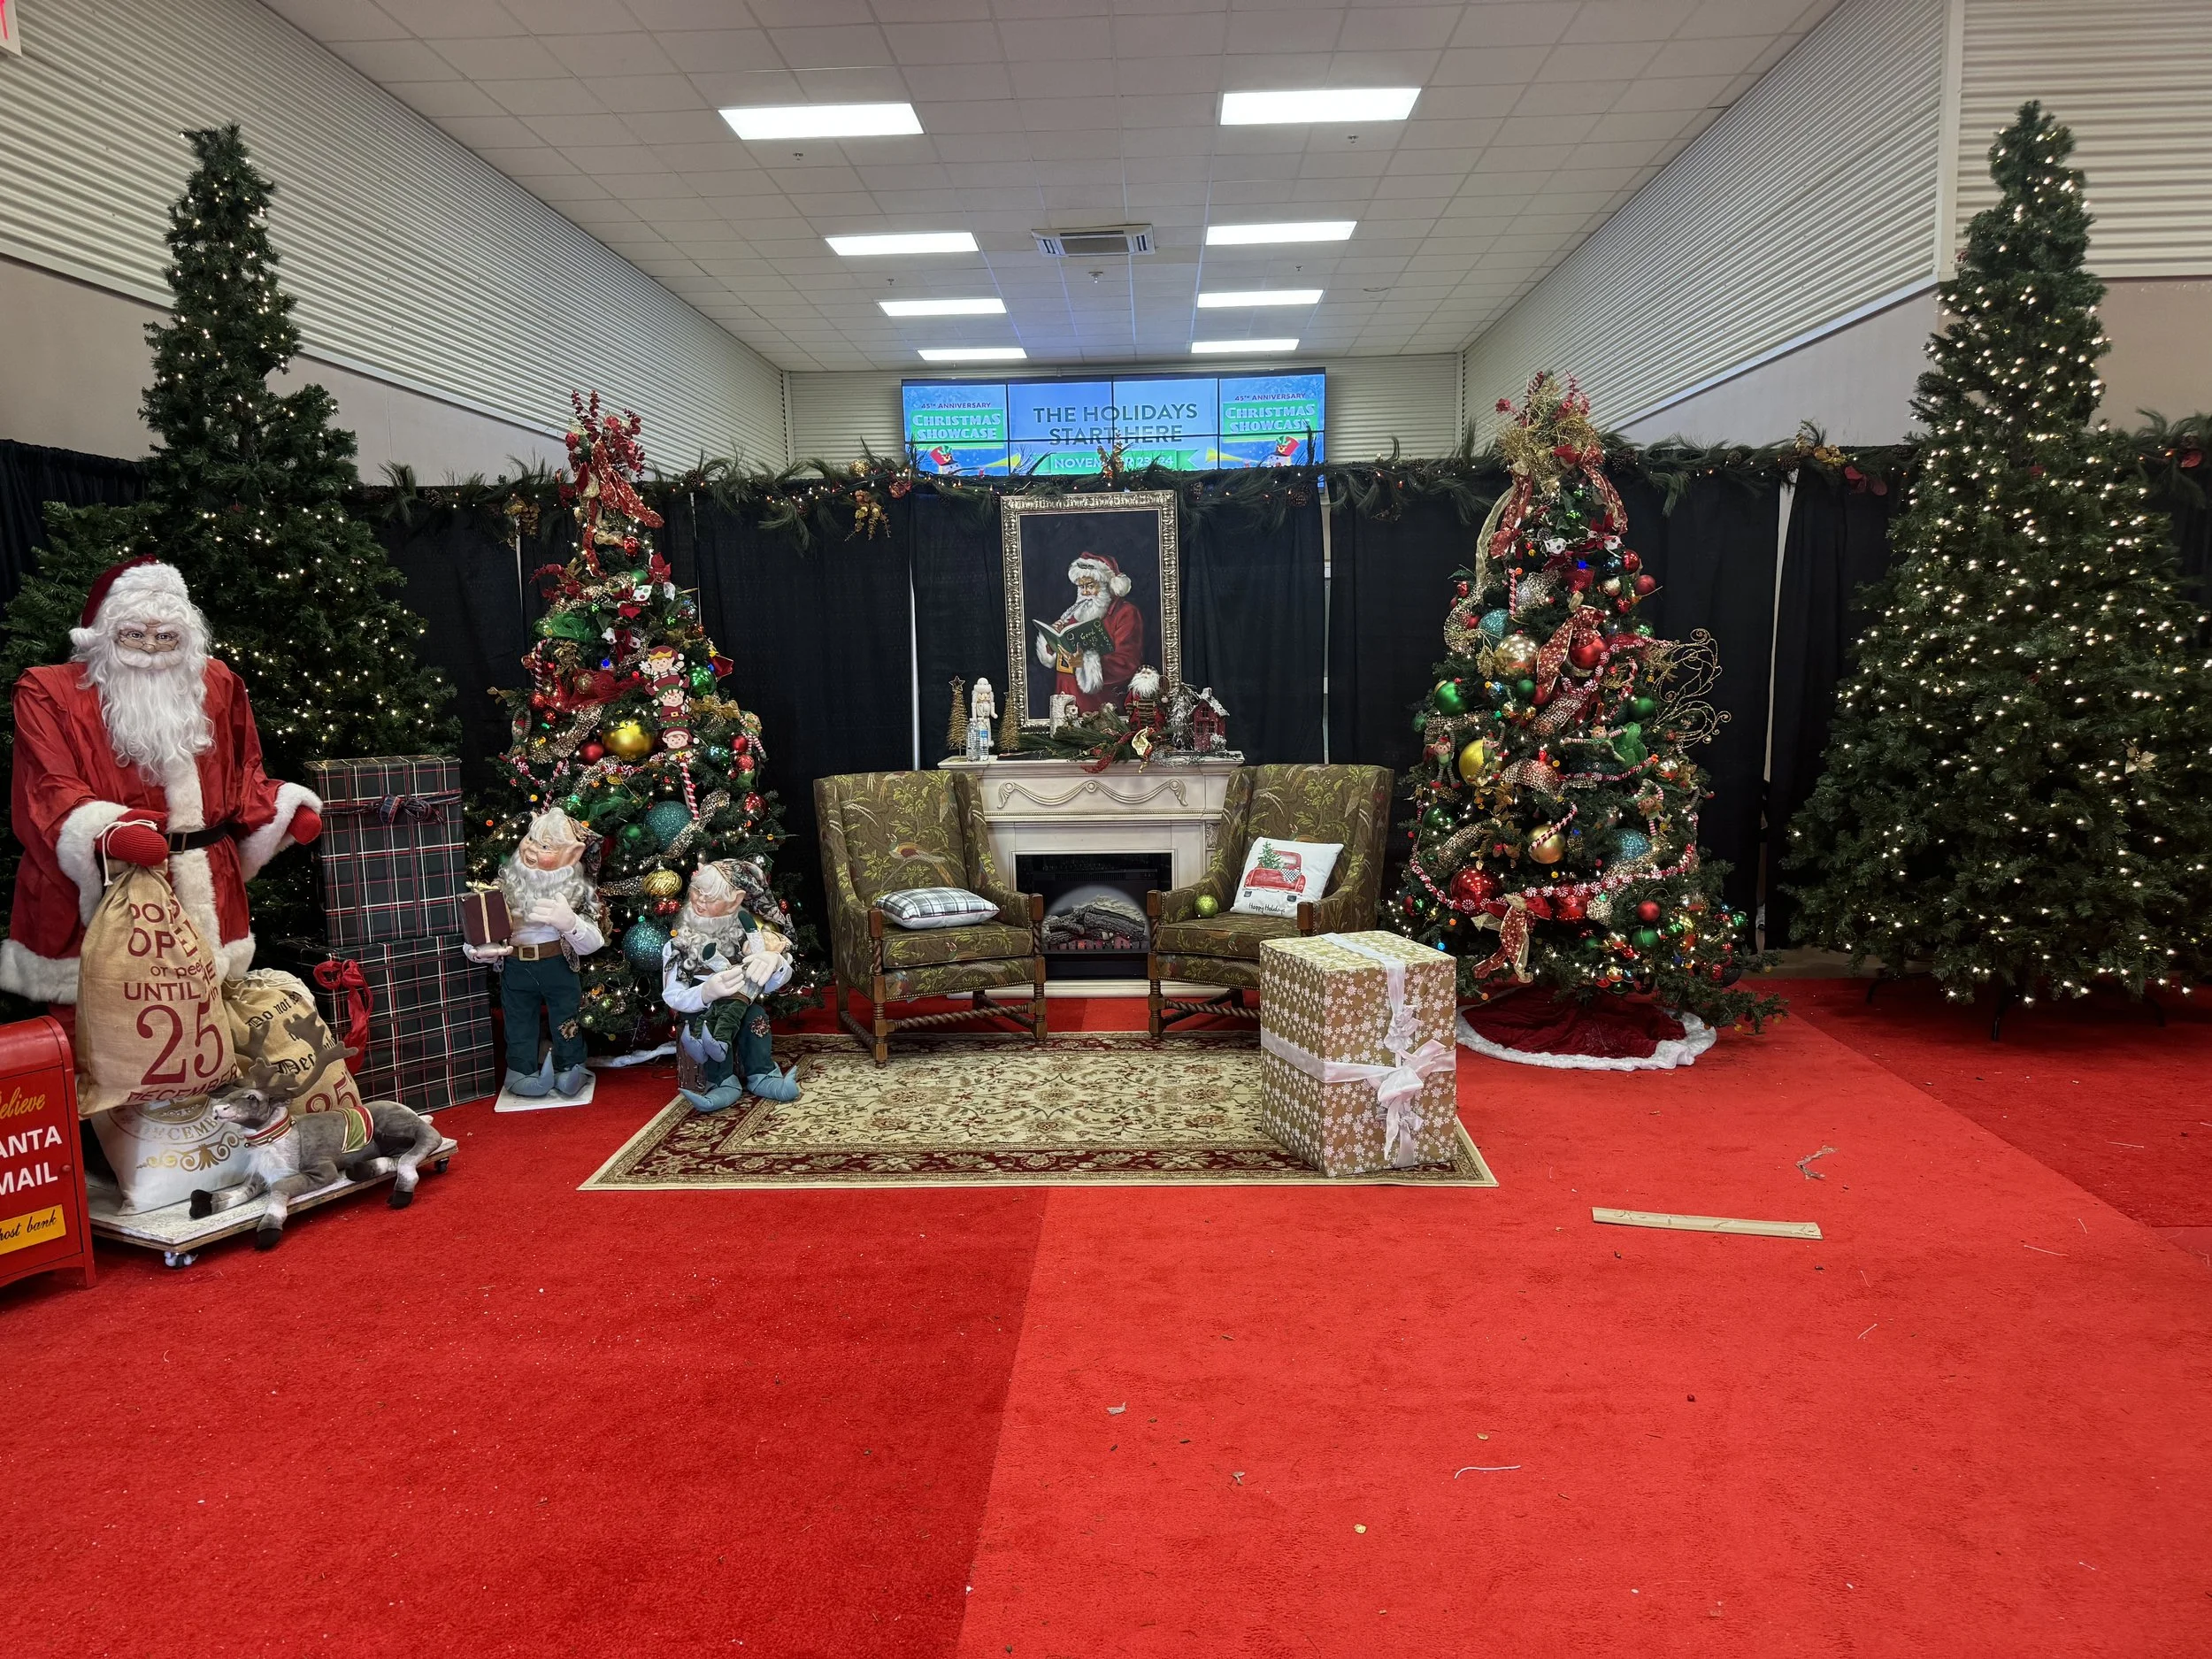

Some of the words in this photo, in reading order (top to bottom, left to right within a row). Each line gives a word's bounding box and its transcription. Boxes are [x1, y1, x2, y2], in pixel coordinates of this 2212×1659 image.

[1033, 406, 1076, 423] THE
[1083, 403, 1198, 422] HOLIDAYS
[918, 427, 996, 441] SHOWCASE
[1049, 426, 1113, 445] START
[1124, 425, 1183, 443] HERE
[1248, 902, 1263, 913] Happy
[150, 966, 168, 977] or
[124, 981, 202, 1002] UNTIL
[0, 1087, 46, 1120] elieve
[27, 1209, 58, 1233] bank
